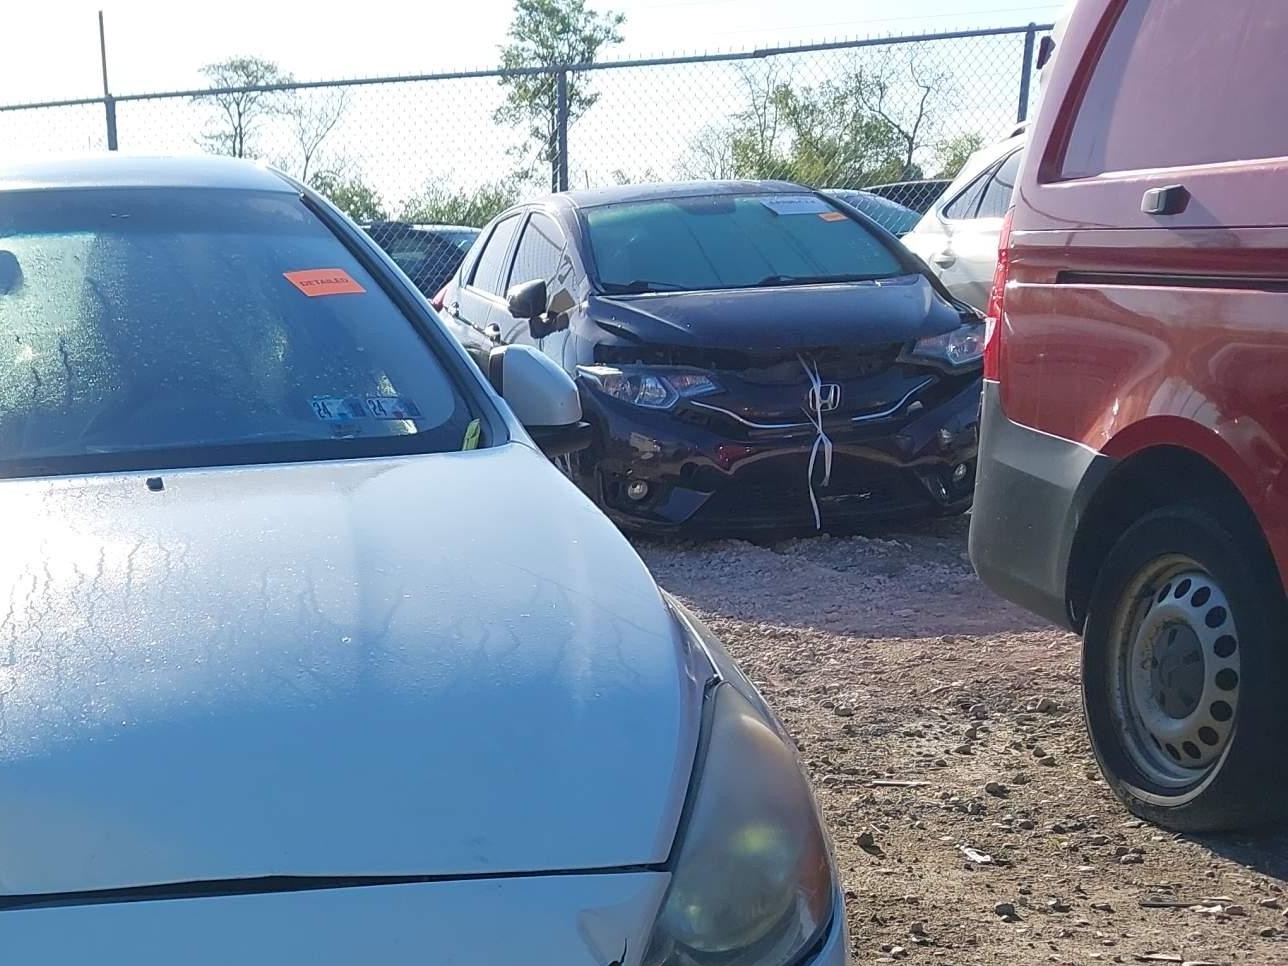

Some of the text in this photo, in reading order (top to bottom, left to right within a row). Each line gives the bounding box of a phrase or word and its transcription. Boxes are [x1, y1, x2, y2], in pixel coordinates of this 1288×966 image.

[299, 277, 349, 287] DETAILED
[312, 400, 333, 418] 24
[367, 399, 388, 417] 24
